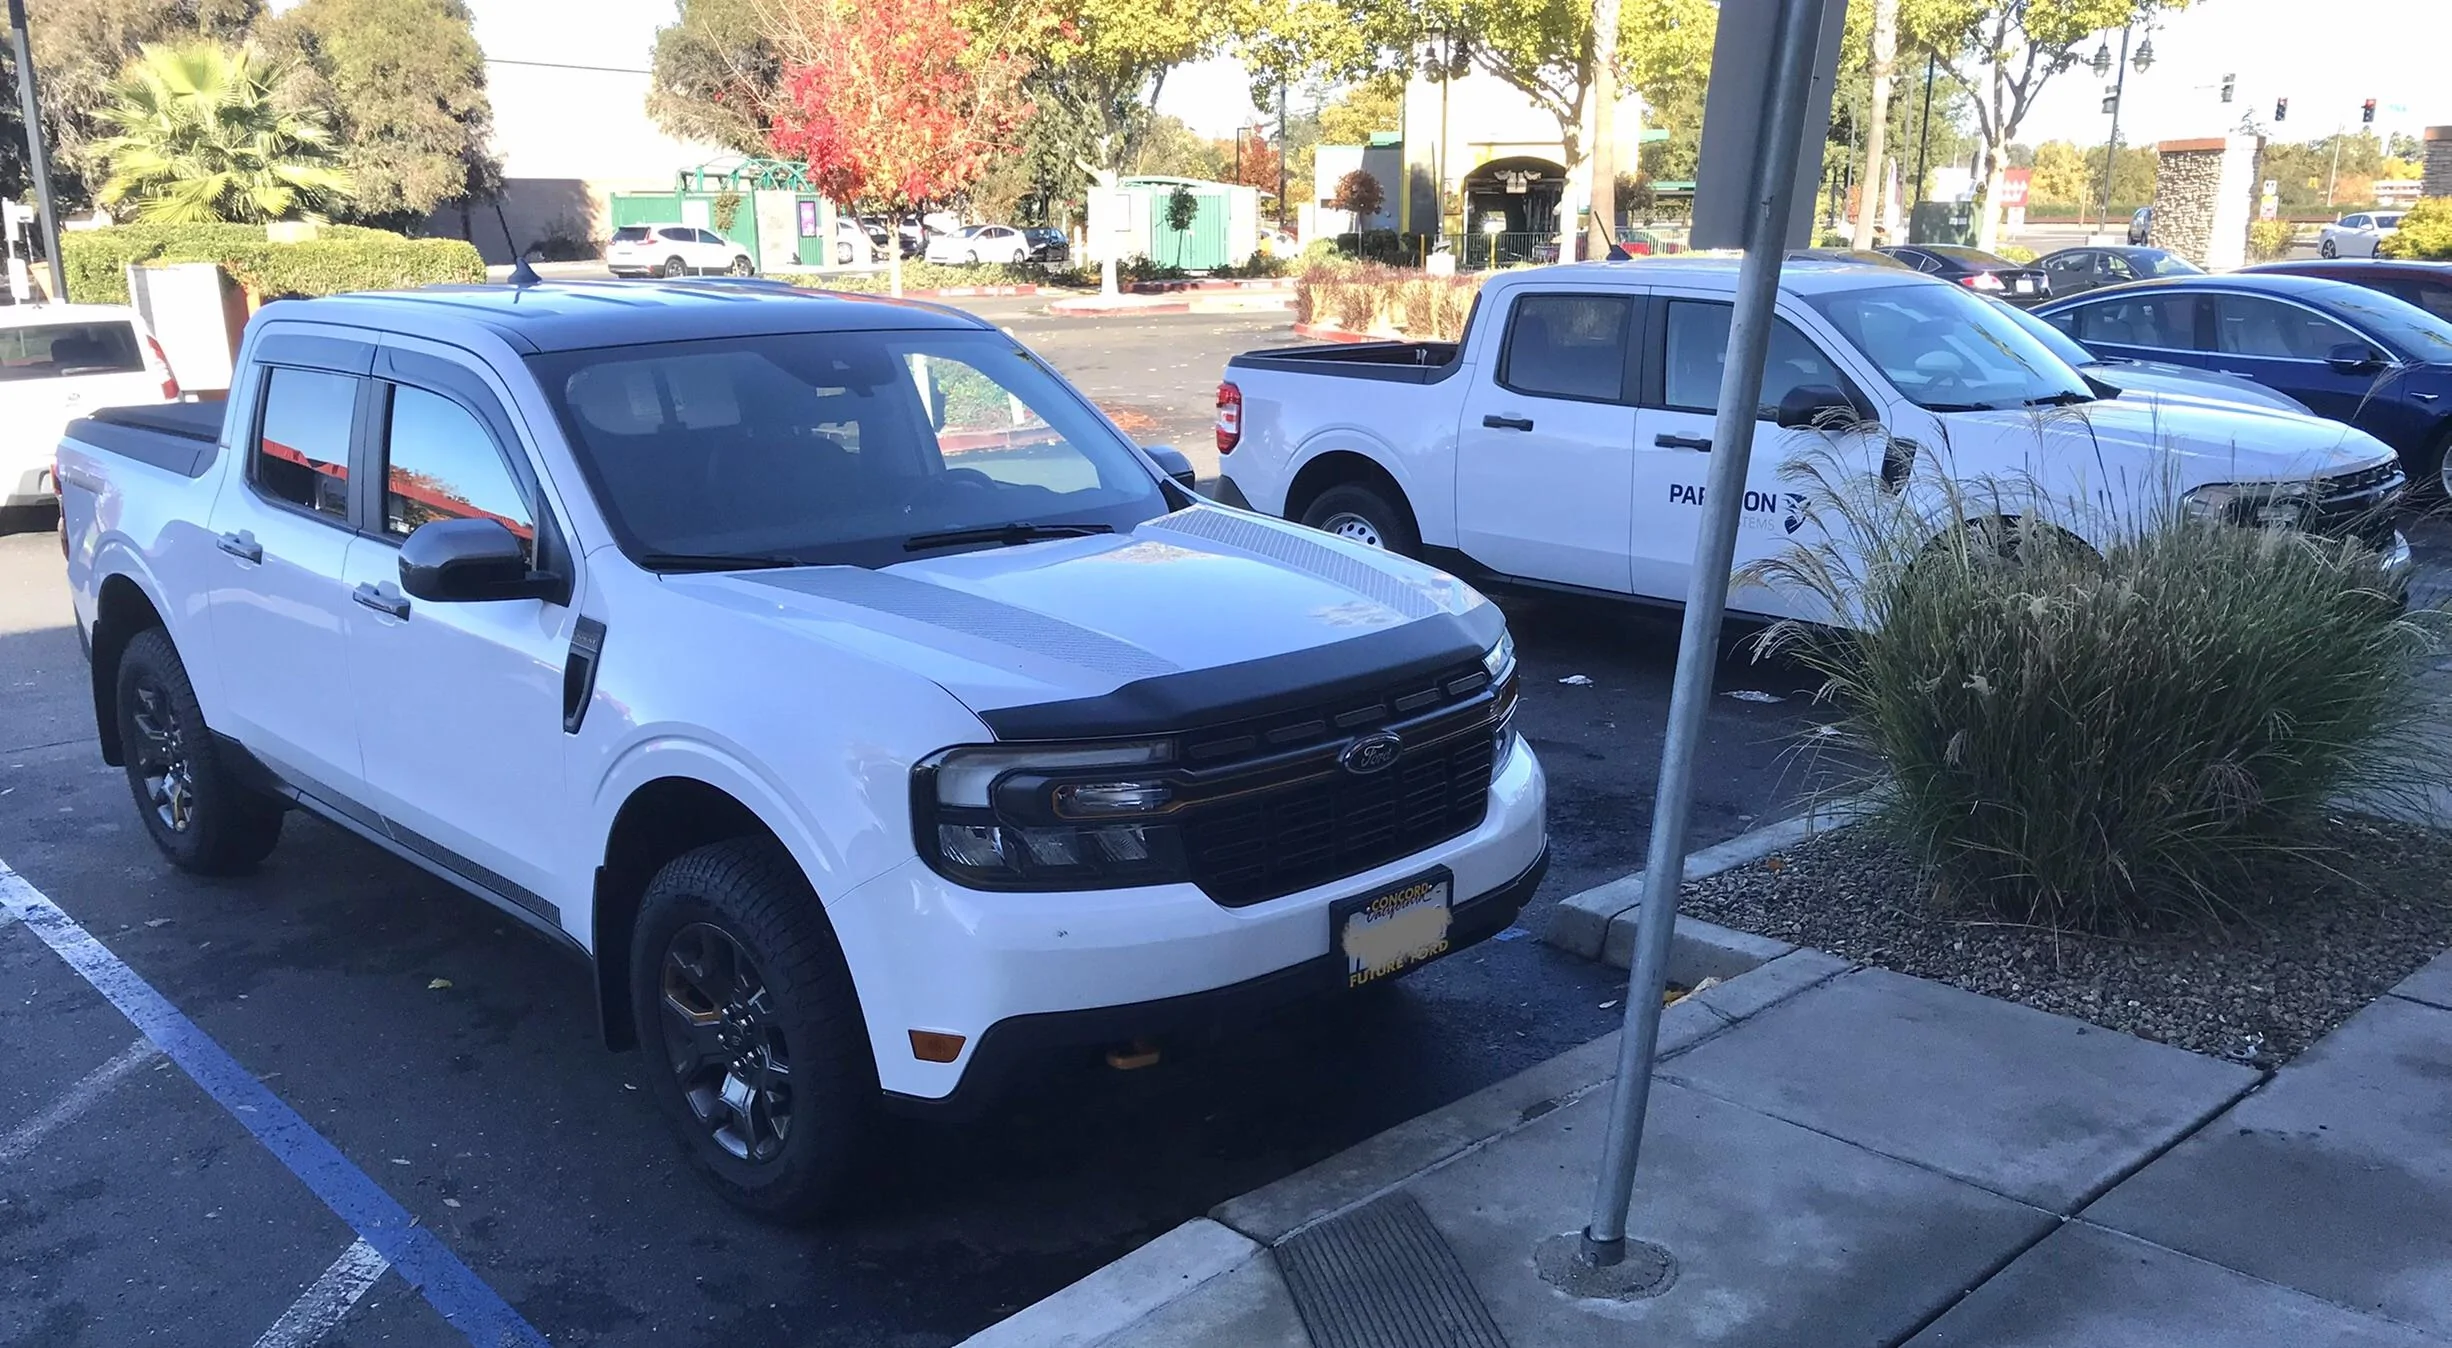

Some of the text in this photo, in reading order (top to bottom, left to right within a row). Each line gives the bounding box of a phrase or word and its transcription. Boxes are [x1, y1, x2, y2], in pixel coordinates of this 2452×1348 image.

[1361, 743, 1393, 767] Ford
[1372, 882, 1429, 911] CONCORD
[1349, 956, 1404, 988] FUTURE
